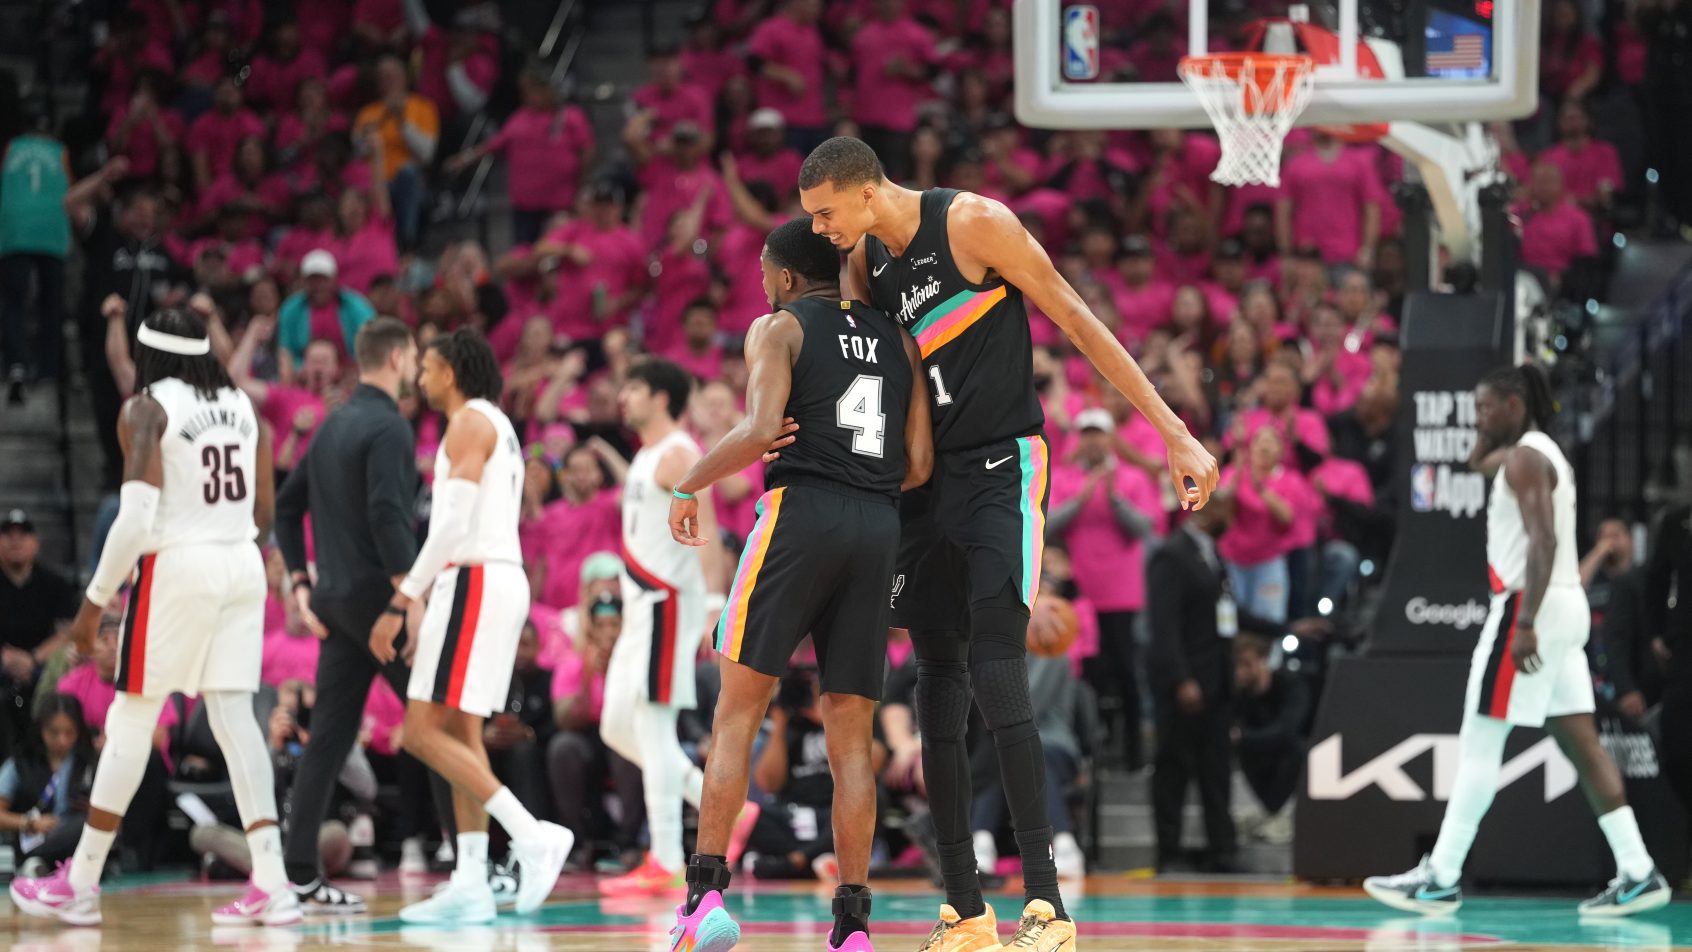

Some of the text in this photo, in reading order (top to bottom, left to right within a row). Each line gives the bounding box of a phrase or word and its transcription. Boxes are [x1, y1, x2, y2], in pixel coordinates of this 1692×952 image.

[900, 275, 941, 322] Antonio
[838, 334, 879, 364] FOX
[929, 364, 953, 406] 1
[179, 410, 238, 445] WILLIAMS
[836, 373, 886, 459] 4
[1413, 390, 1454, 426] TAP
[201, 443, 247, 505] 35
[1434, 464, 1485, 519] App
[1405, 596, 1487, 630] Google
